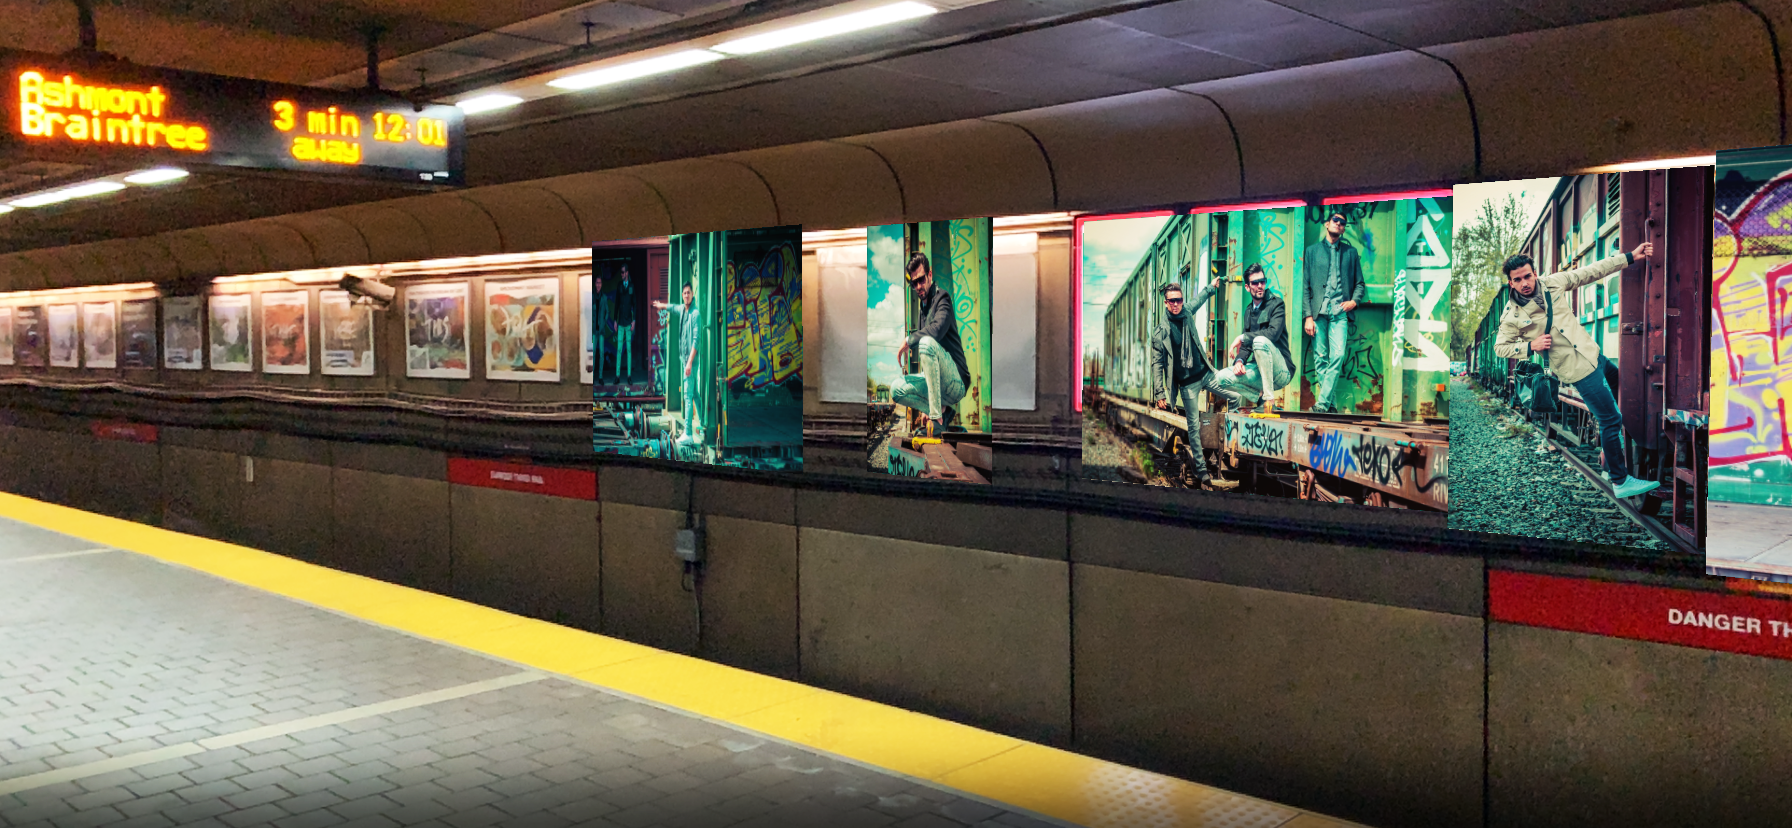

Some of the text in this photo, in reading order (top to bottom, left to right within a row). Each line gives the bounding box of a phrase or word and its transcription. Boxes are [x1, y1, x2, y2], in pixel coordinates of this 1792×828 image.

[18, 70, 166, 118] Ashmont
[19, 101, 208, 151] Braintree
[272, 100, 446, 147] 3 min 12:01
[291, 136, 361, 164] away
[1668, 608, 1761, 635] DANGER
